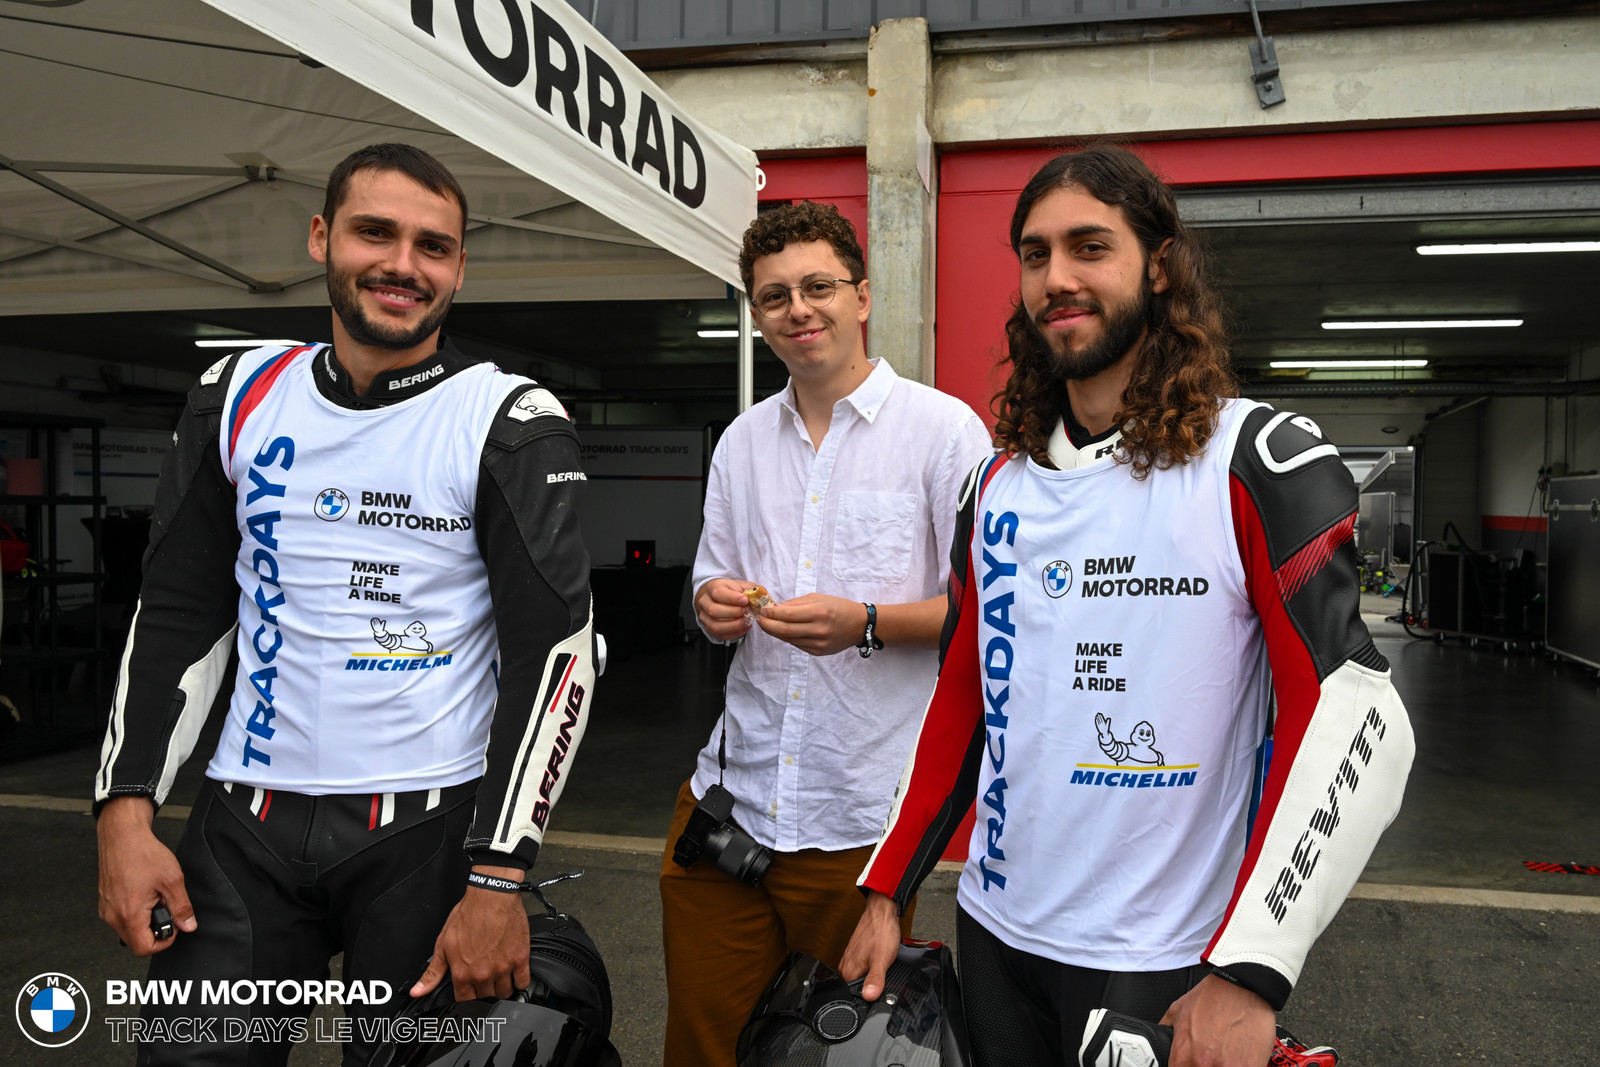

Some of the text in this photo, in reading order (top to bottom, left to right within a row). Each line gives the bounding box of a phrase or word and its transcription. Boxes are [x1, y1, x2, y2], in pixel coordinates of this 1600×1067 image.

[388, 364, 445, 391] BERING
[630, 445, 661, 454] TRACK
[664, 445, 688, 454] DAYS
[361, 491, 412, 509] BMW
[358, 510, 472, 532] MOTORRAD
[351, 561, 400, 576] MAKE
[1083, 555, 1136, 576] BMW
[350, 575, 384, 589] LIFE
[1081, 577, 1209, 598] MOTORRAD
[242, 436, 295, 767] TRACKDAYS
[348, 589, 402, 604] A RIDE
[1076, 643, 1123, 657] MAKE
[1074, 660, 1107, 674] LIFE
[1072, 677, 1126, 692] A RIDE
[981, 510, 1020, 891] TRACKDAYS
[531, 681, 585, 834] BERING
[1069, 770, 1198, 788] MICHELIN
